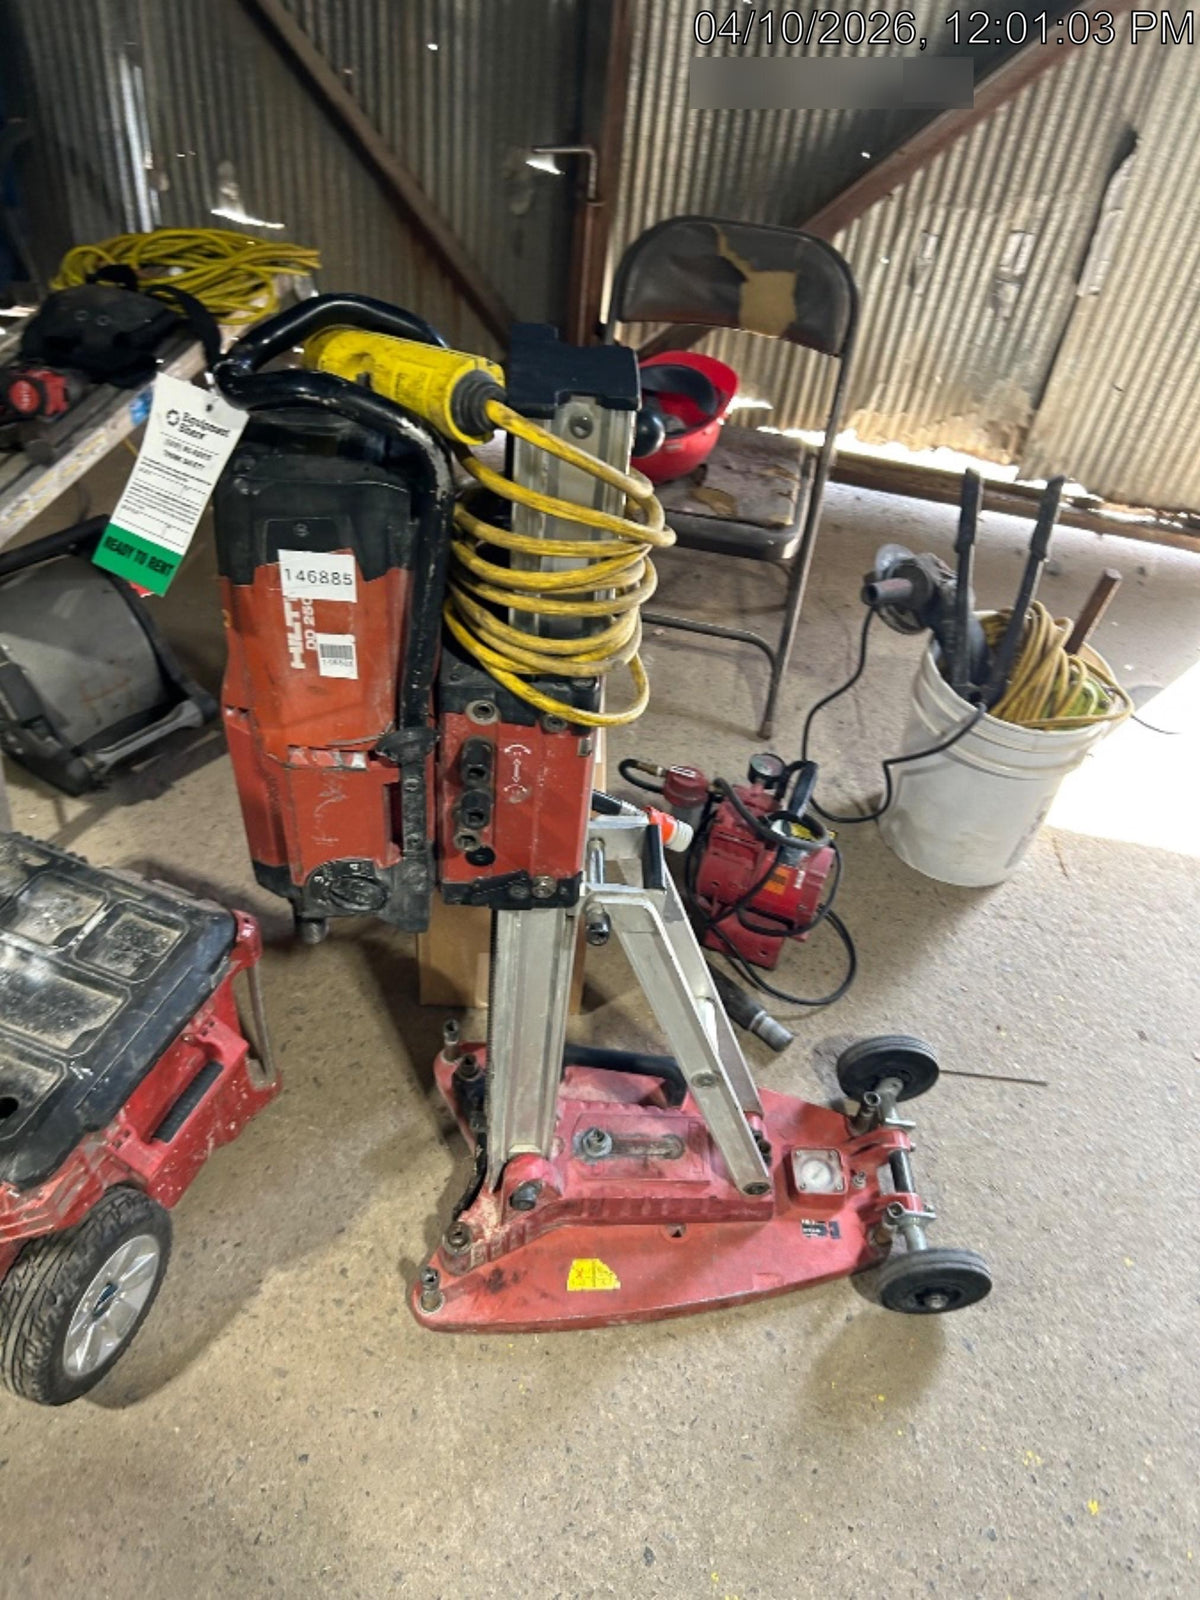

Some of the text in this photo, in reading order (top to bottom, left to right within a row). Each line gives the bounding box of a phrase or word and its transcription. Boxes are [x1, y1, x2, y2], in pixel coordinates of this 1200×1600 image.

[104, 536, 175, 577] READY TO RENT
[285, 567, 354, 586] 146885
